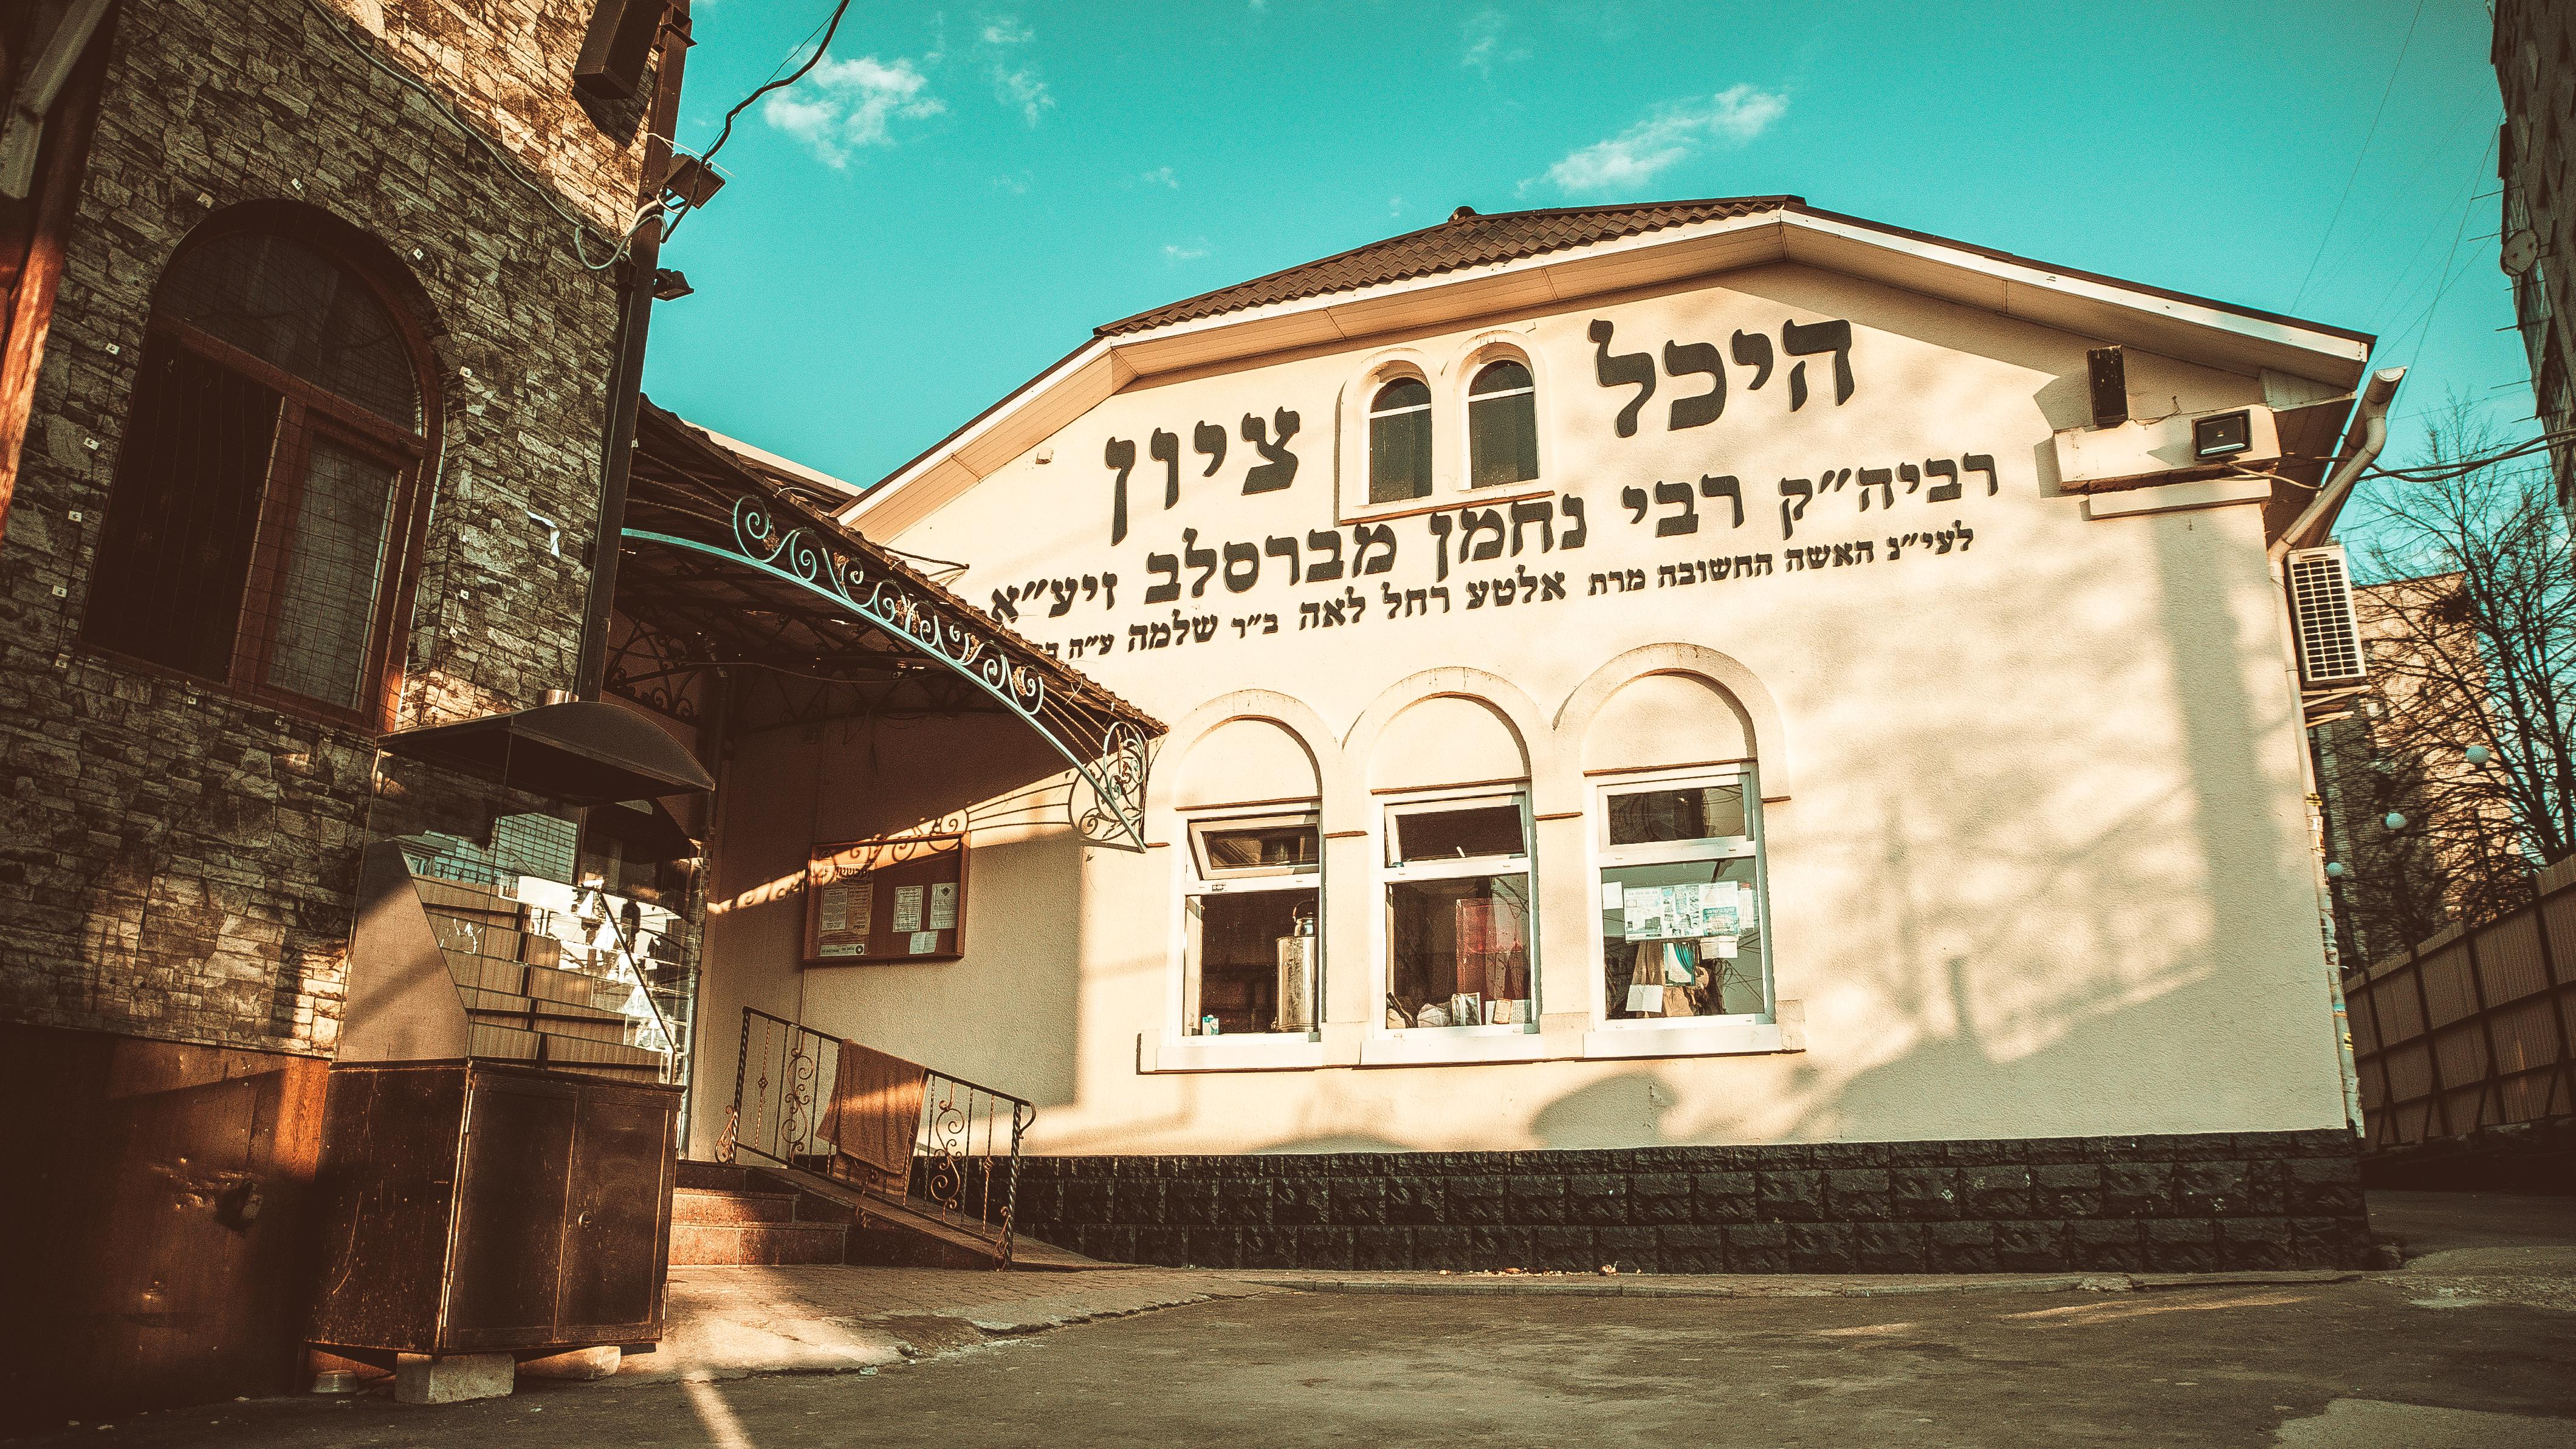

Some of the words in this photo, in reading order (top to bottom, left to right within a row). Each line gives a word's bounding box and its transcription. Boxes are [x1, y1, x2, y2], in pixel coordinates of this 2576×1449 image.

[1588, 318, 1855, 438] היכל
[1105, 406, 1300, 546] ציון
[1621, 473, 1745, 538] רבי
[1429, 493, 1587, 581] נחמן
[1785, 540, 1875, 572] האשה
[1144, 524, 1397, 604] מברסלב
[1589, 569, 1646, 595] מרת
[1658, 553, 1773, 587] החשובה
[1299, 586, 1366, 630] לאה
[1381, 581, 1451, 620] רחל
[1466, 564, 1566, 609] אלטע
[1128, 609, 1218, 653] שלמה
